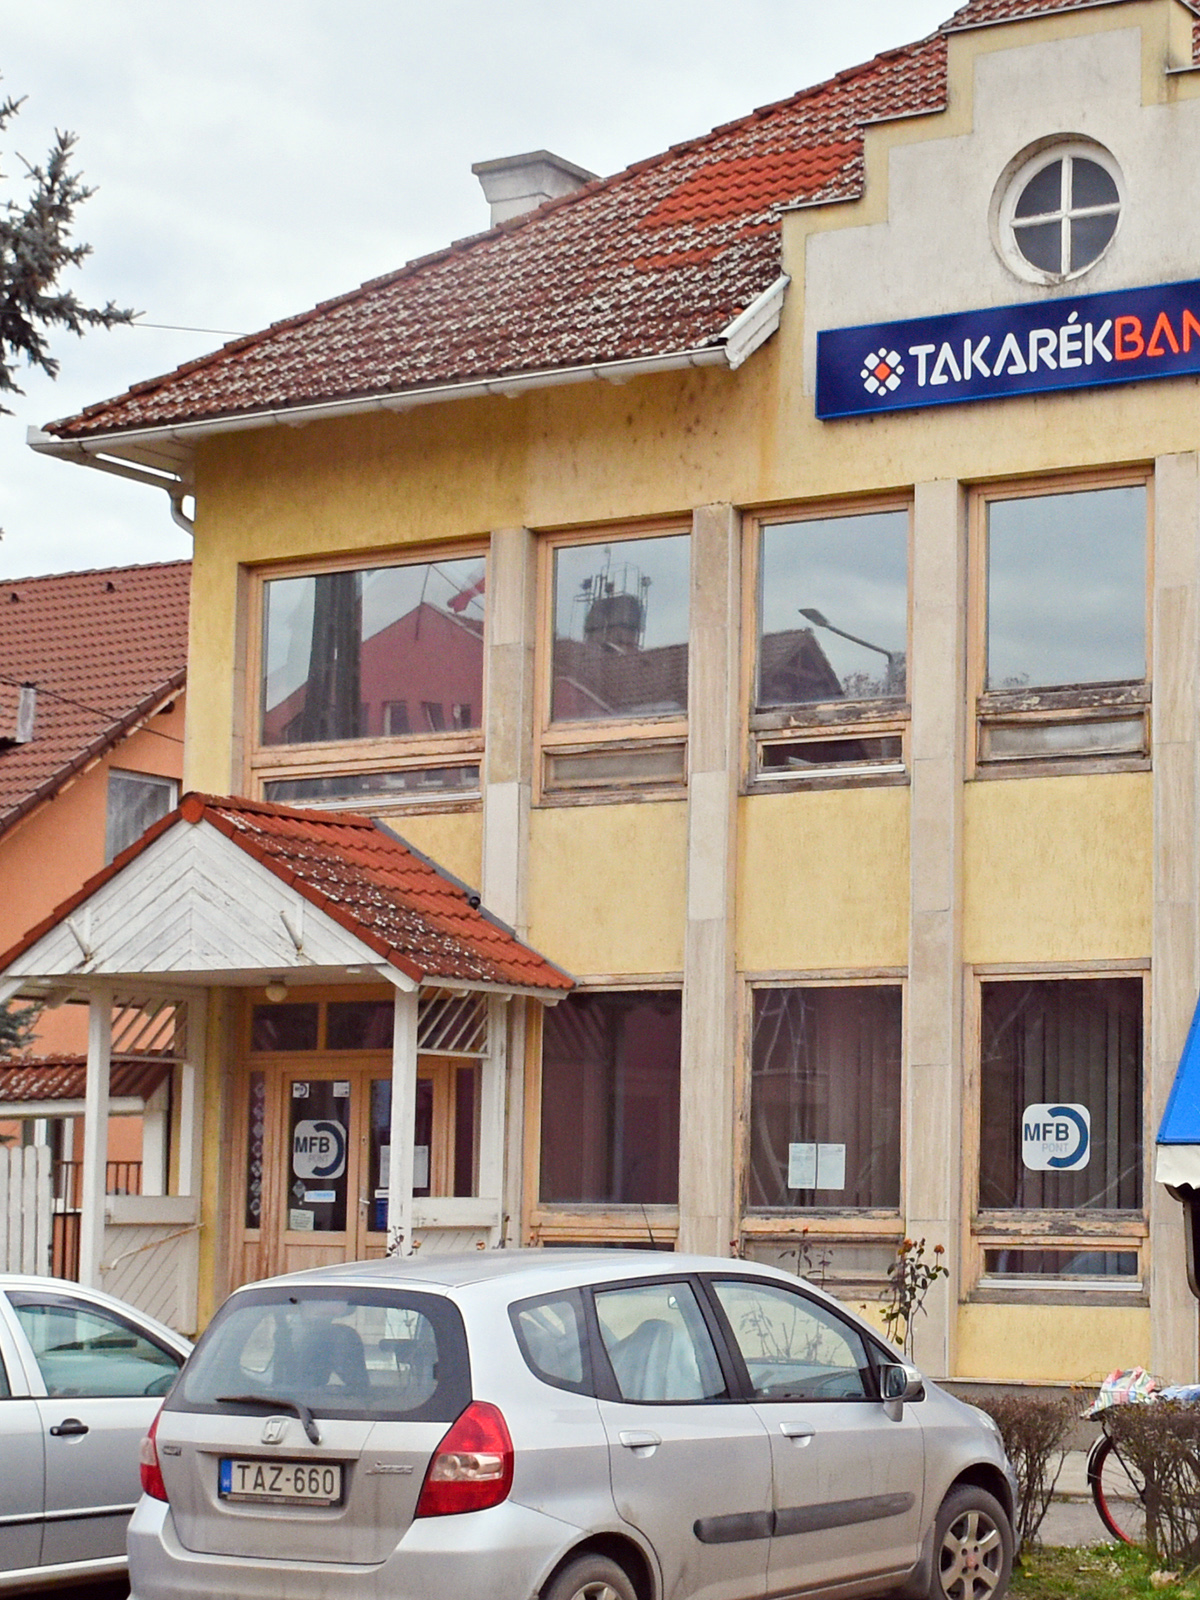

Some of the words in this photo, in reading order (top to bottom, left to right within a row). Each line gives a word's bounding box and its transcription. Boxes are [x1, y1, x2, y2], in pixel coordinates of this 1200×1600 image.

[1024, 1123, 1069, 1141] MFB
[295, 1136, 330, 1153] MFB
[1041, 1143, 1069, 1153] PONT
[237, 1464, 335, 1495] TAZ-660
